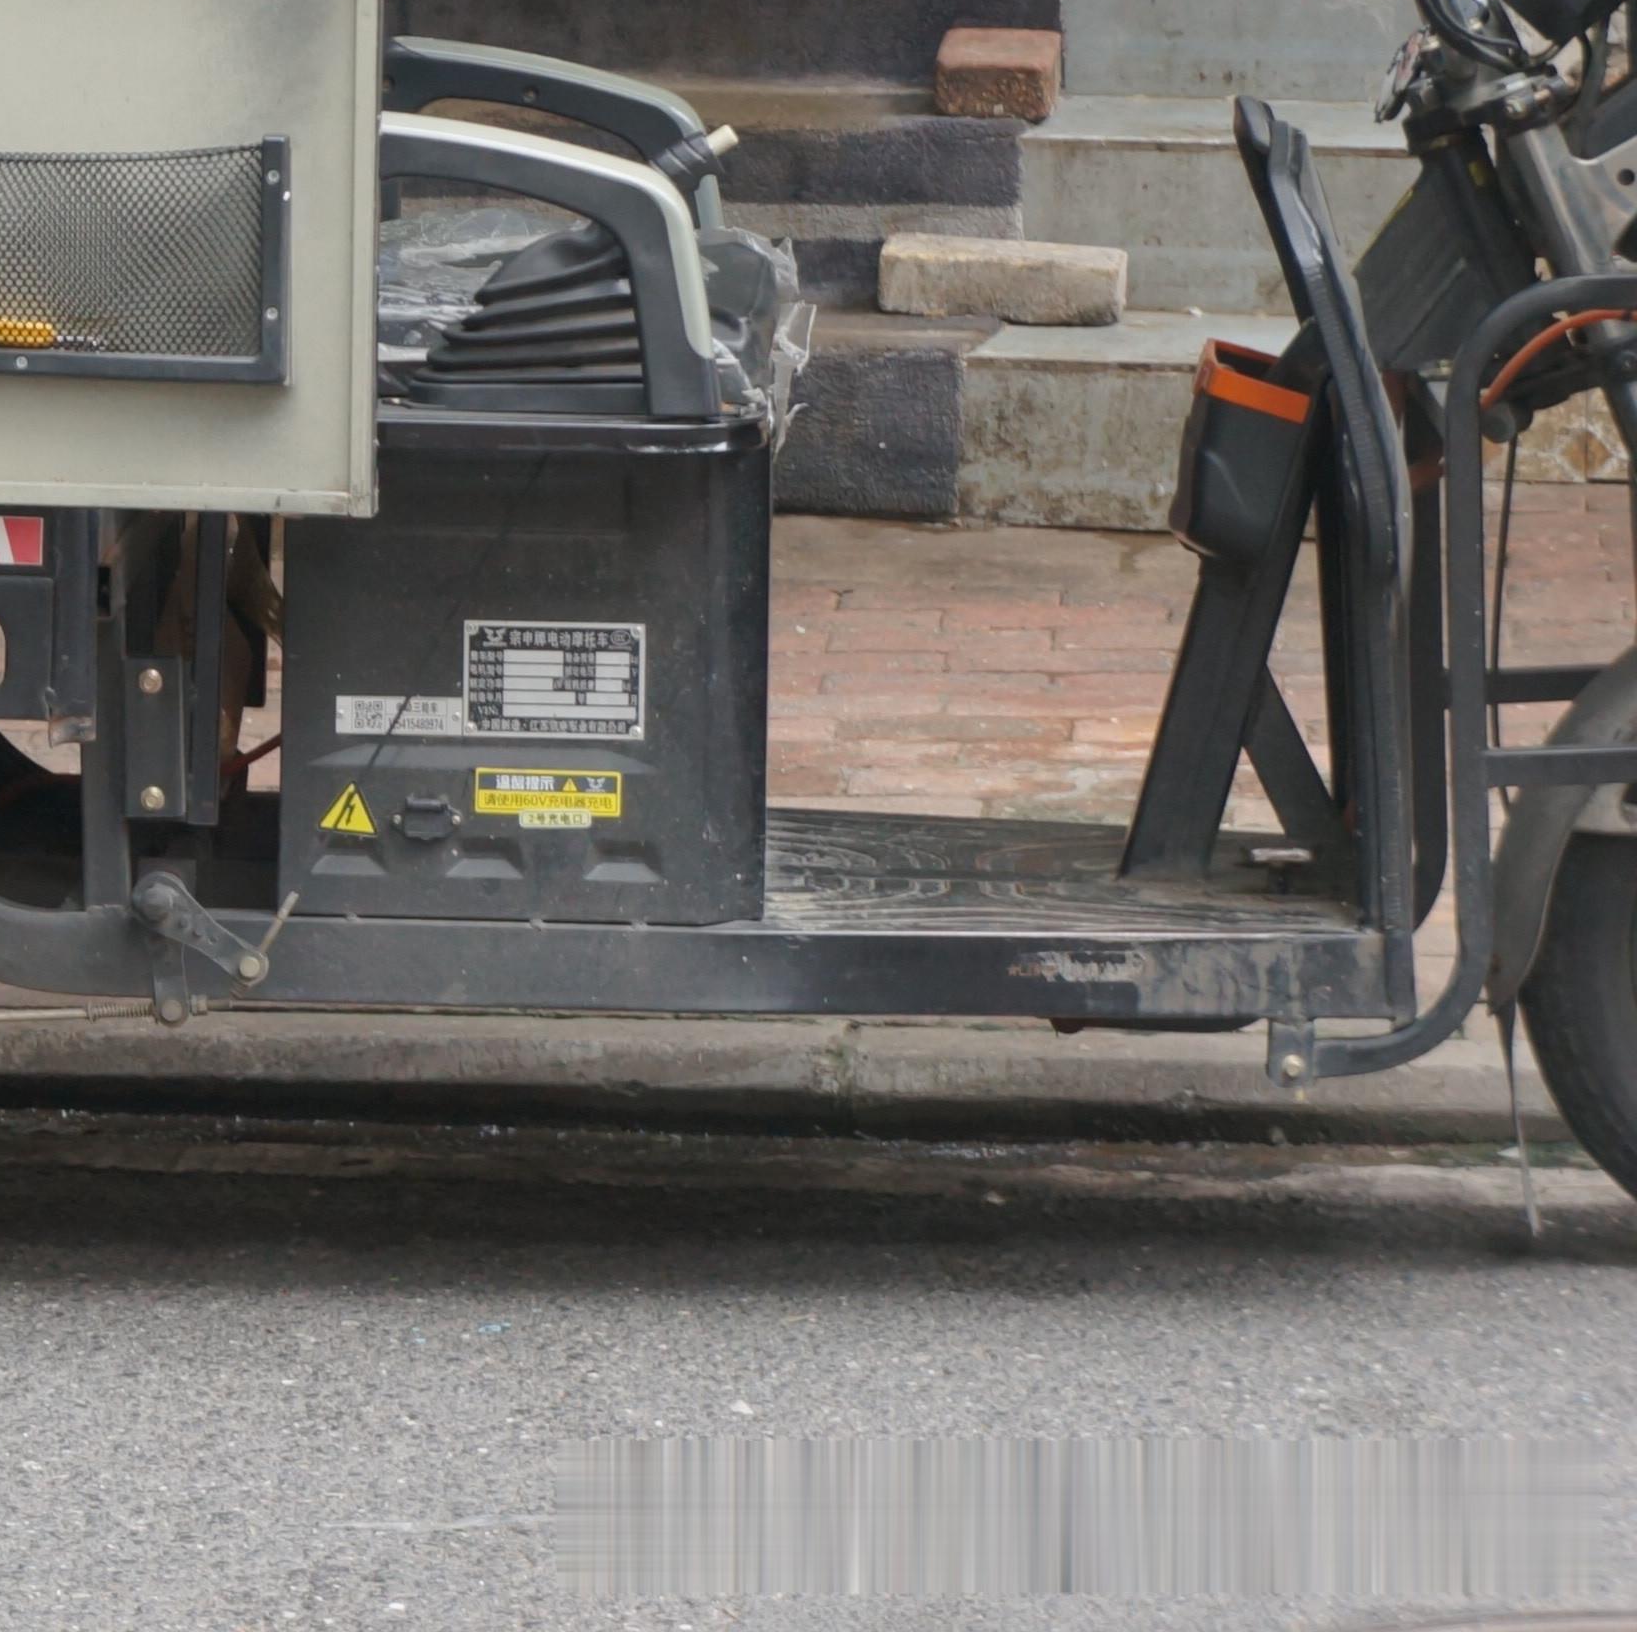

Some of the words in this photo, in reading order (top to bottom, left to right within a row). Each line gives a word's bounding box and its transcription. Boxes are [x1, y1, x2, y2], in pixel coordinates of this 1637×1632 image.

[509, 630, 609, 648] 宗申牌电动摩托车
[496, 774, 555, 791] 温馨提示
[484, 792, 613, 809] 请使用60V充电器充电
